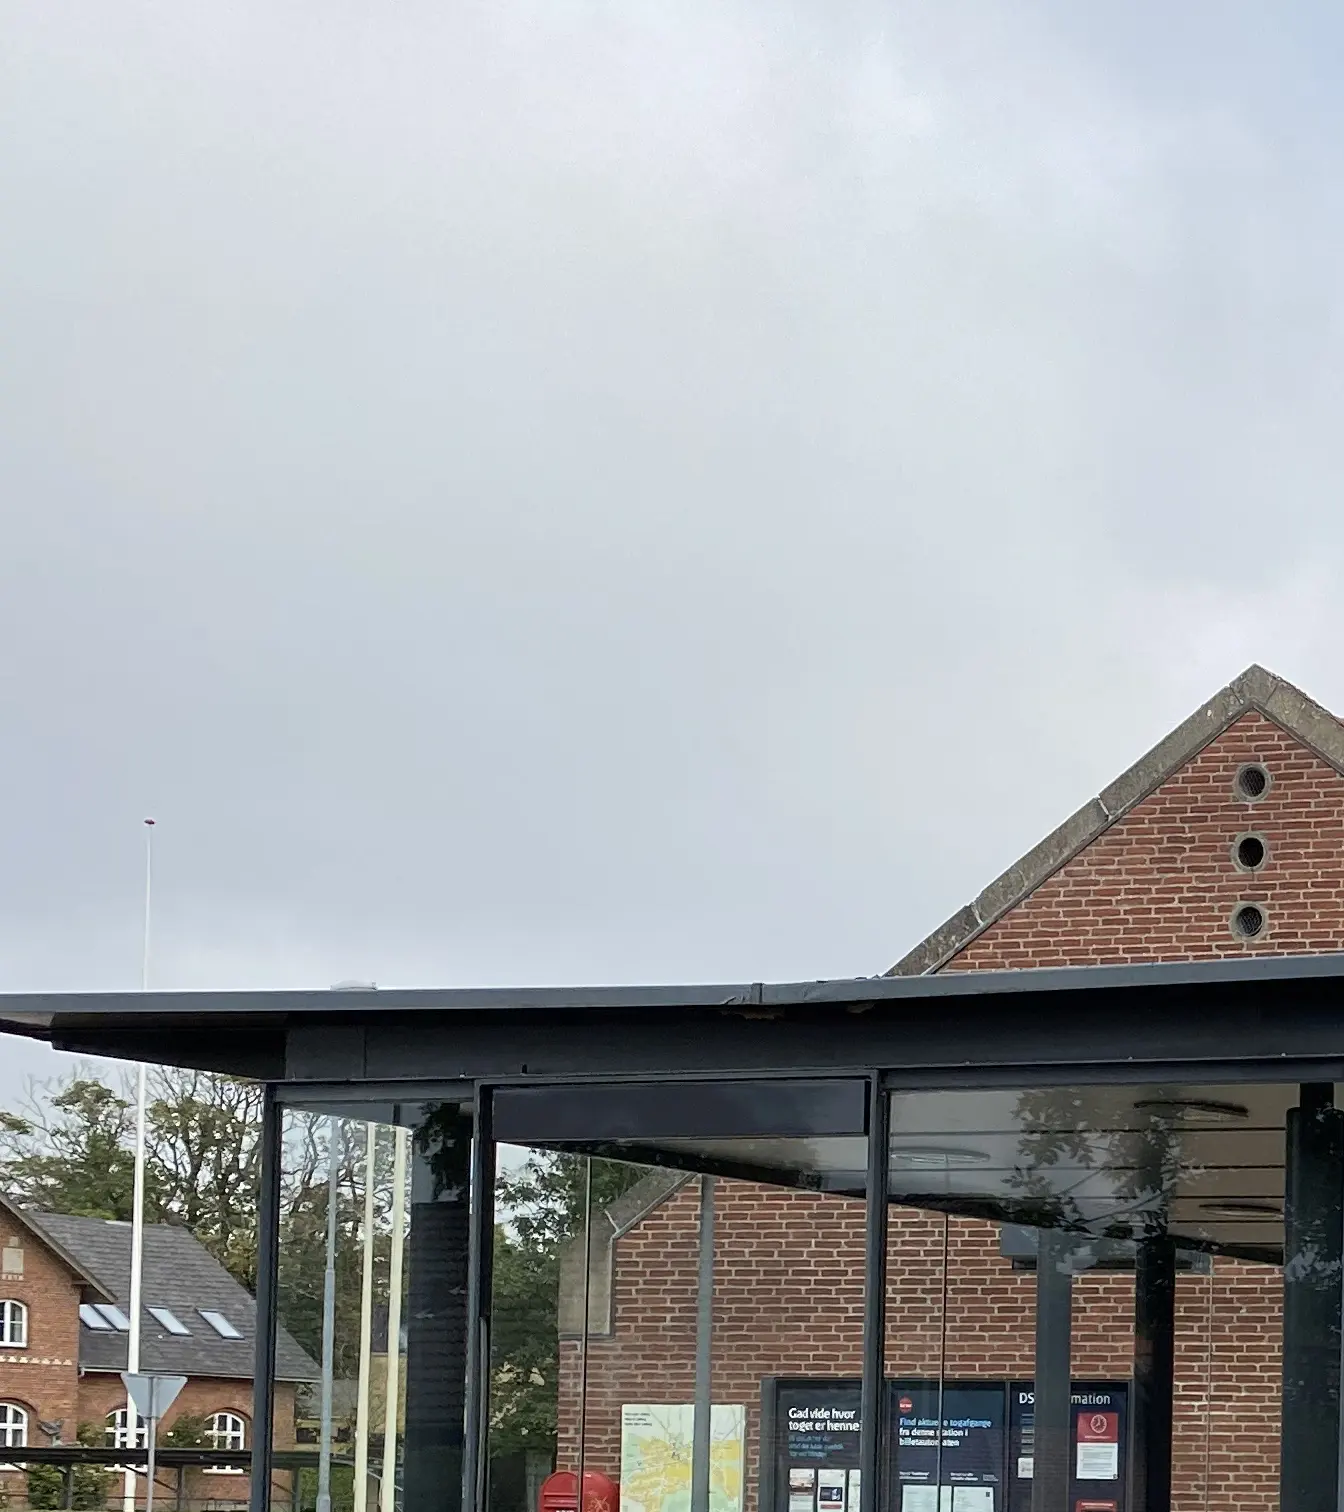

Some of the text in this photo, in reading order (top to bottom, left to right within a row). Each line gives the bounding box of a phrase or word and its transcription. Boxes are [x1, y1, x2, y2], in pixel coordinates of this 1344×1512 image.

[1019, 1392, 1111, 1405] DS mation
[788, 1407, 856, 1419] Gad vide hvor
[788, 1421, 814, 1433] toget
[814, 1423, 825, 1431] er
